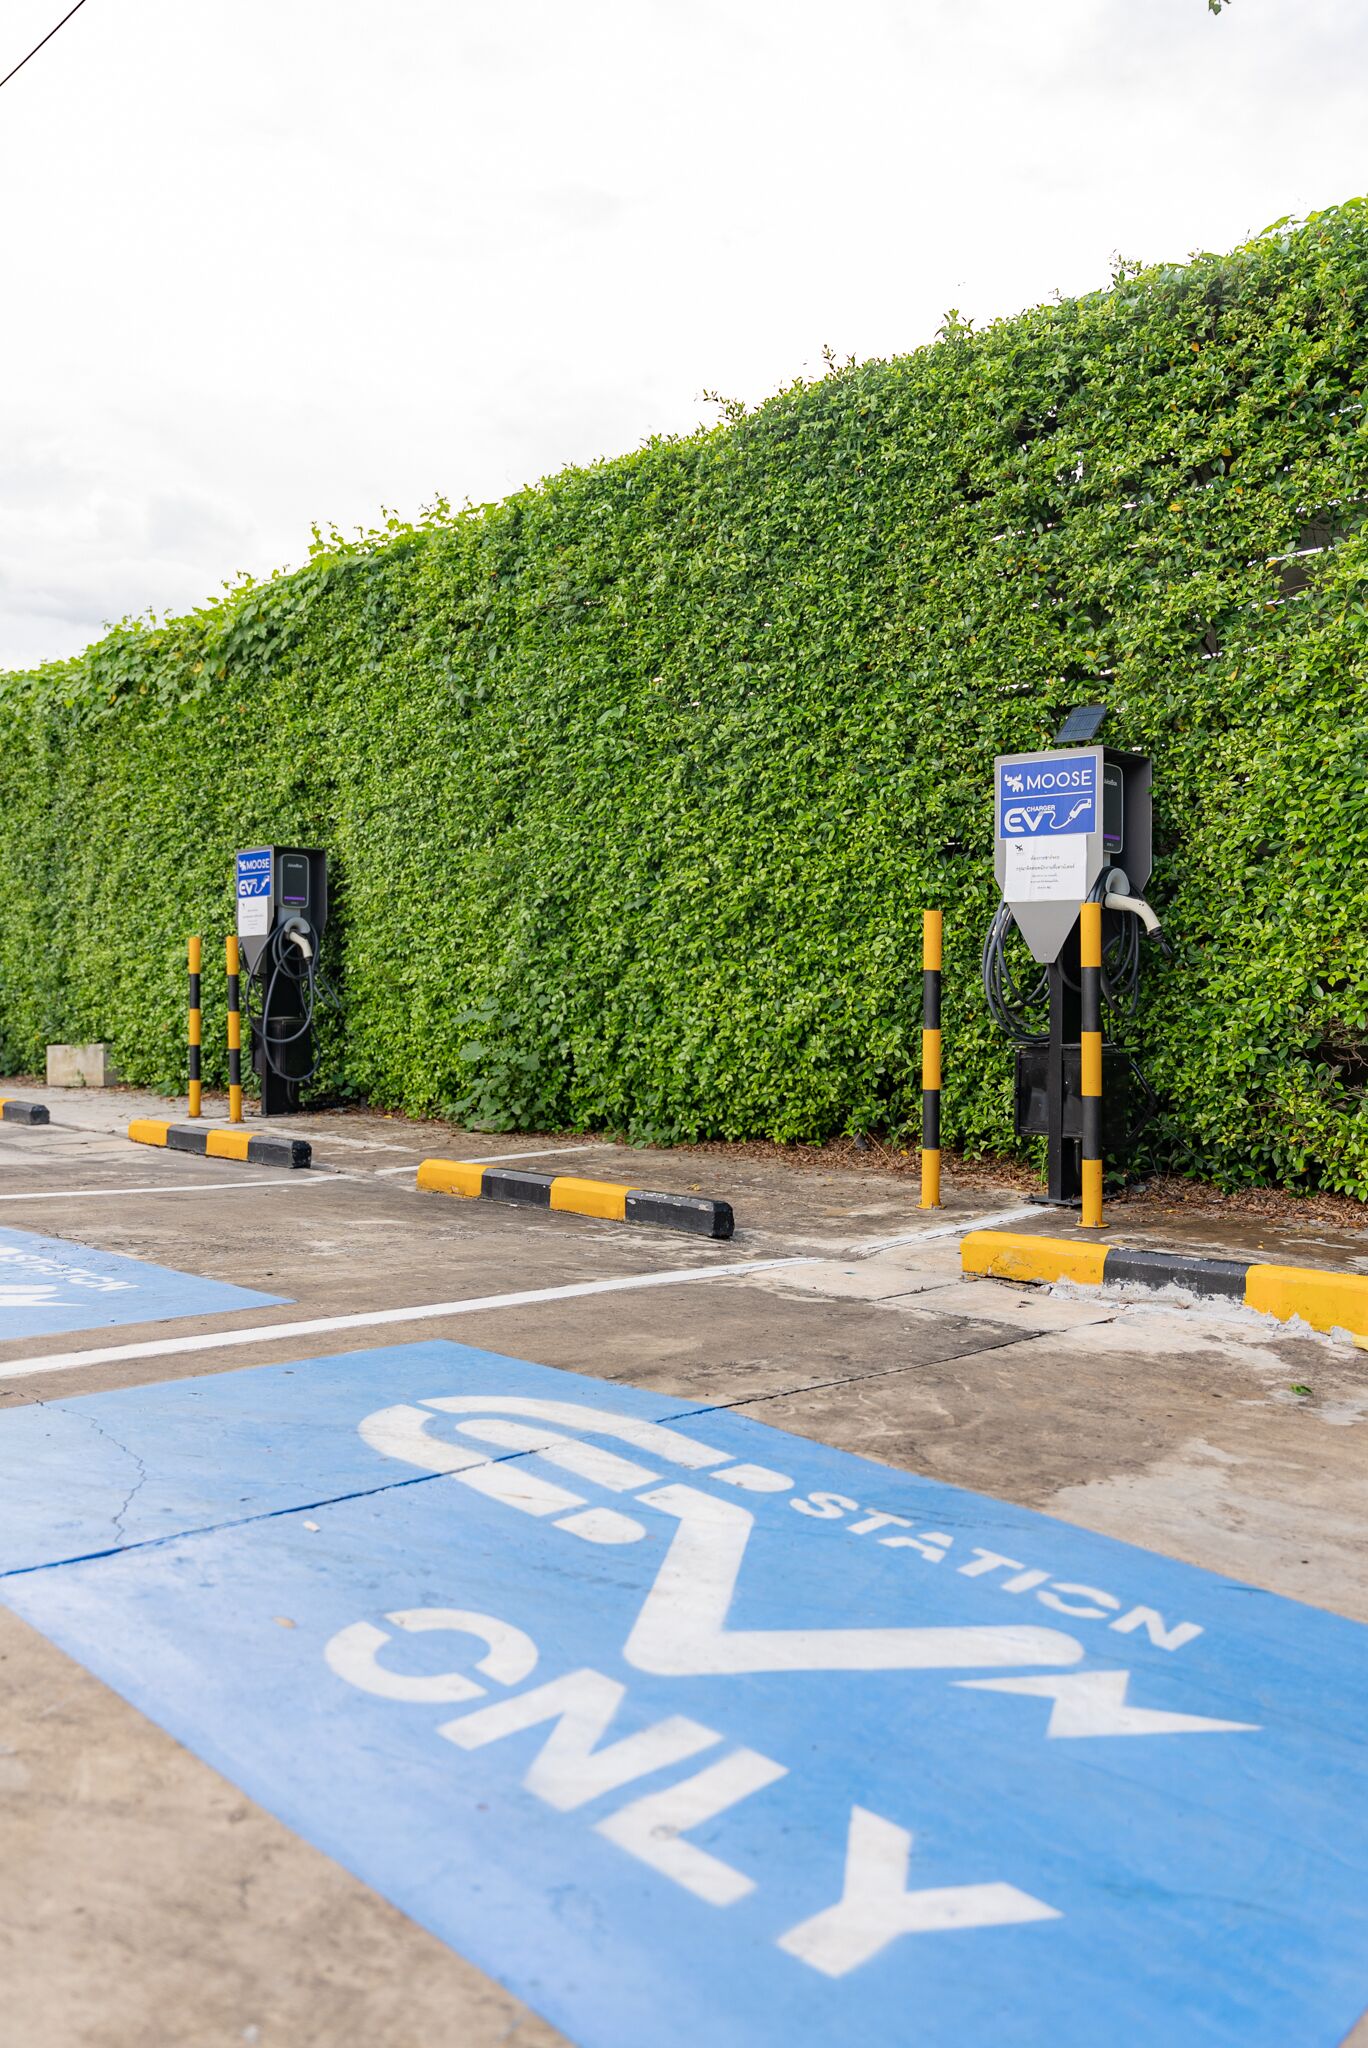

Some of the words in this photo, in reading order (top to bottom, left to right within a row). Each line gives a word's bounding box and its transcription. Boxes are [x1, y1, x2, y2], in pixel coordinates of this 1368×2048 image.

[1027, 769, 1093, 790] MOOSE
[1004, 807, 1045, 832] EV
[1026, 804, 1056, 812] CHARGER
[246, 858, 270, 870] MOOSE
[239, 880, 254, 895] EV
[357, 1395, 1085, 1676] EV
[789, 1491, 1204, 1652] STATION
[323, 1607, 1064, 1980] ONLY
